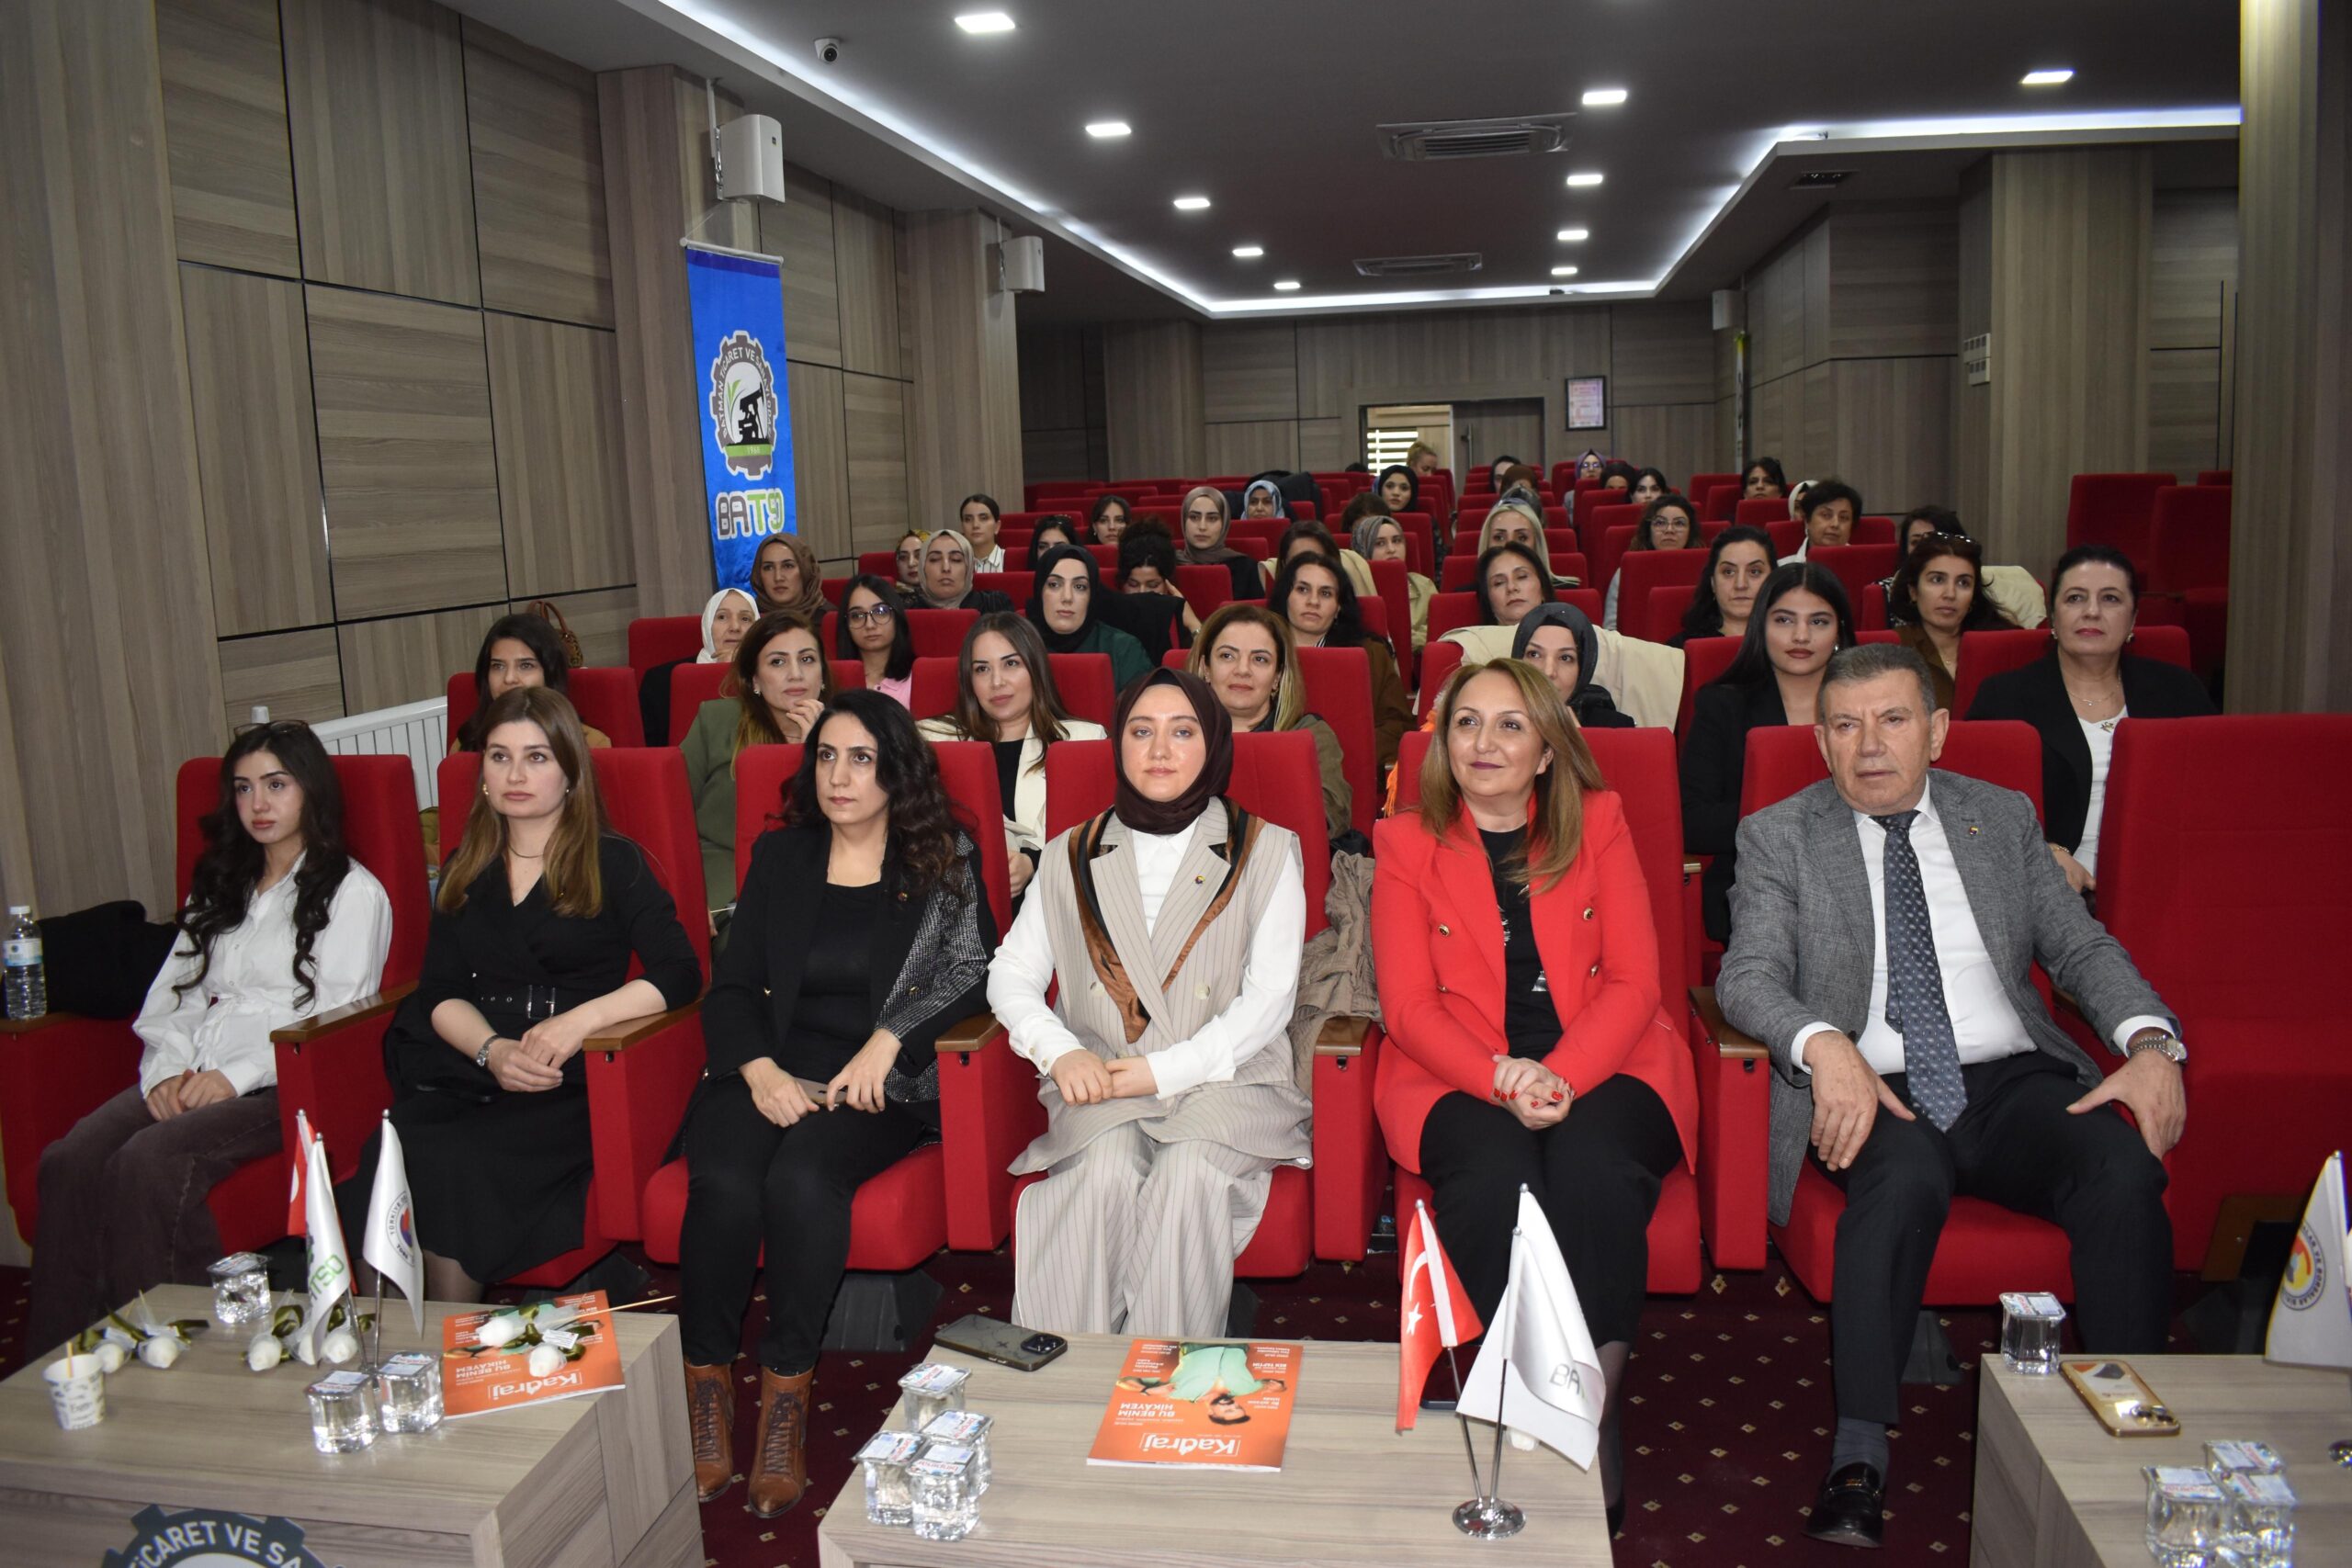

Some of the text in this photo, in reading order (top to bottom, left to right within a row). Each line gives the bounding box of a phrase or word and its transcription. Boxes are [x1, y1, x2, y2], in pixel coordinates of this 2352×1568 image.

[745, 347, 756, 362] VE
[492, 1372, 579, 1401] Kadraj
[1117, 1408, 1176, 1419] BU BENİM
[1142, 1433, 1237, 1457] Kadraj
[129, 1520, 217, 1568] CARET
[224, 1522, 262, 1555] VE
